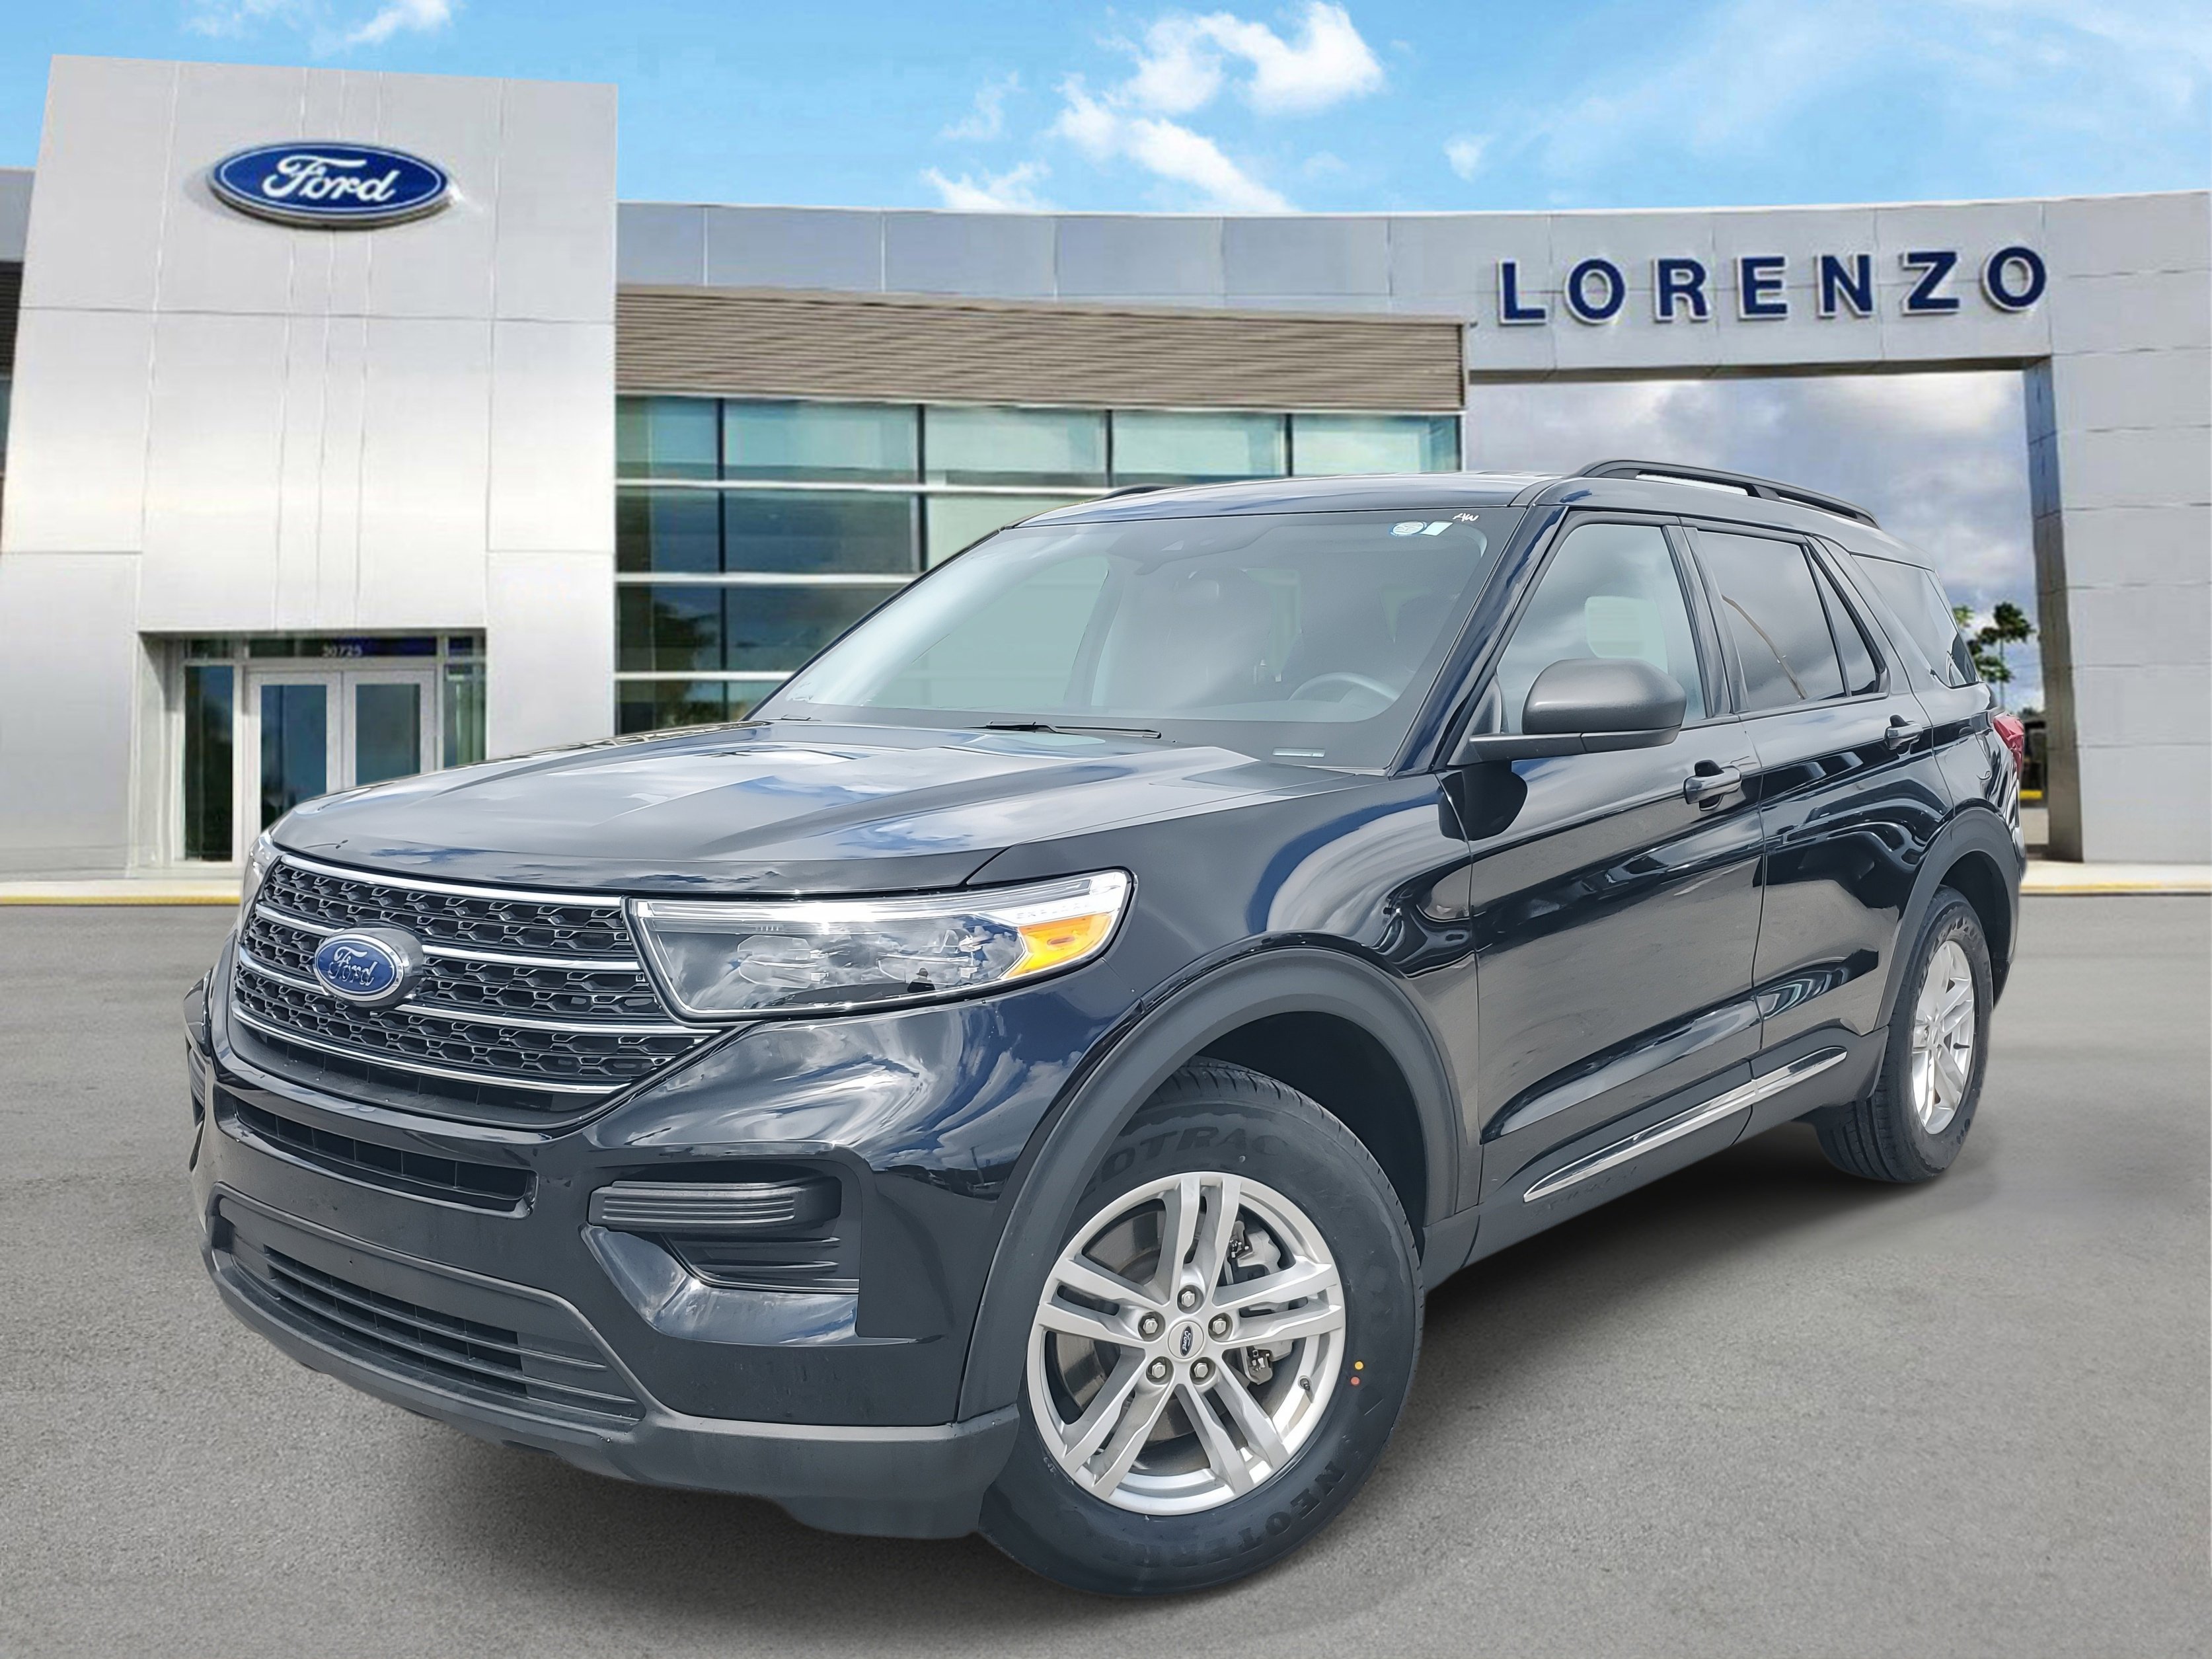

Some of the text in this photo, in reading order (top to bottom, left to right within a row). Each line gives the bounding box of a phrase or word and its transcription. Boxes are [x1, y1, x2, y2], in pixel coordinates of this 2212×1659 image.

[262, 155, 400, 201] Ford
[1499, 247, 2047, 323] LORENZO
[328, 946, 379, 986] Ford
[1182, 1331, 1191, 1351] Ford
